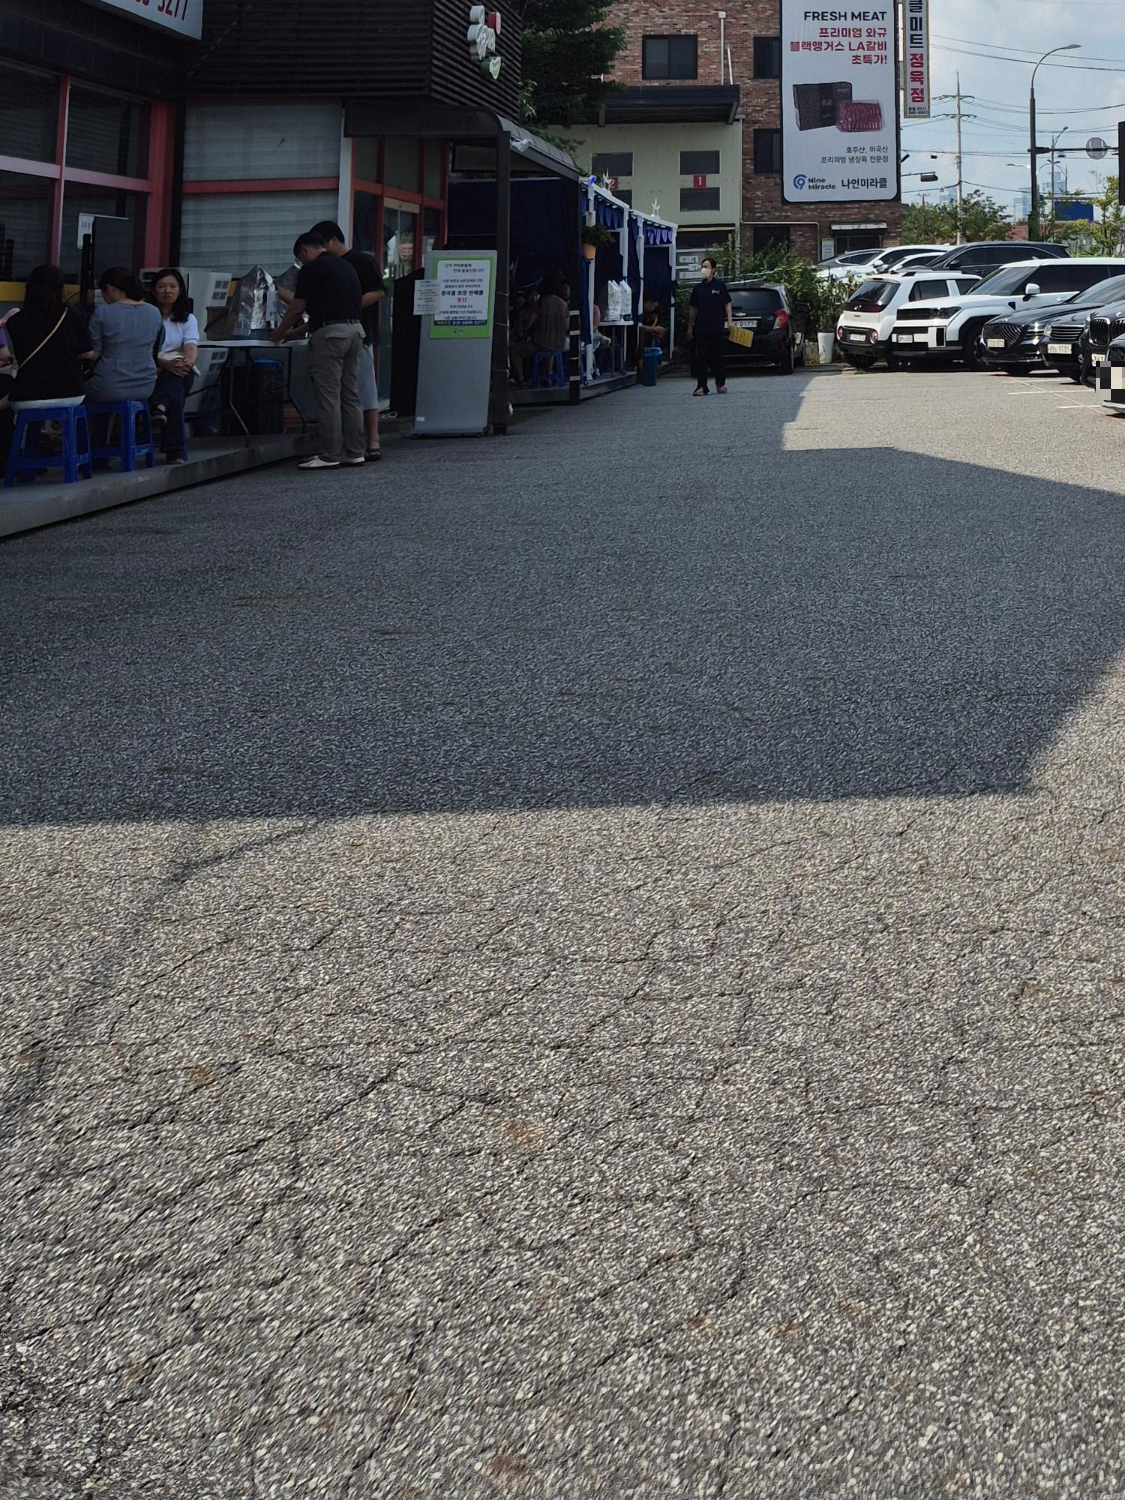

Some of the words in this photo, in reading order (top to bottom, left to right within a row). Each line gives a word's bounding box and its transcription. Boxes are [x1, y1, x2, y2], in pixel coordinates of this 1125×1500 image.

[804, 11, 847, 21] FRESH
[851, 11, 887, 21] MEAT
[819, 27, 862, 38] 프리미엄
[865, 27, 887, 38] 와규
[790, 41, 845, 52] 블랙앵거스
[848, 41, 887, 52] LA갈비
[851, 54, 888, 65] 초특가!
[841, 177, 888, 190] 나인미라클
